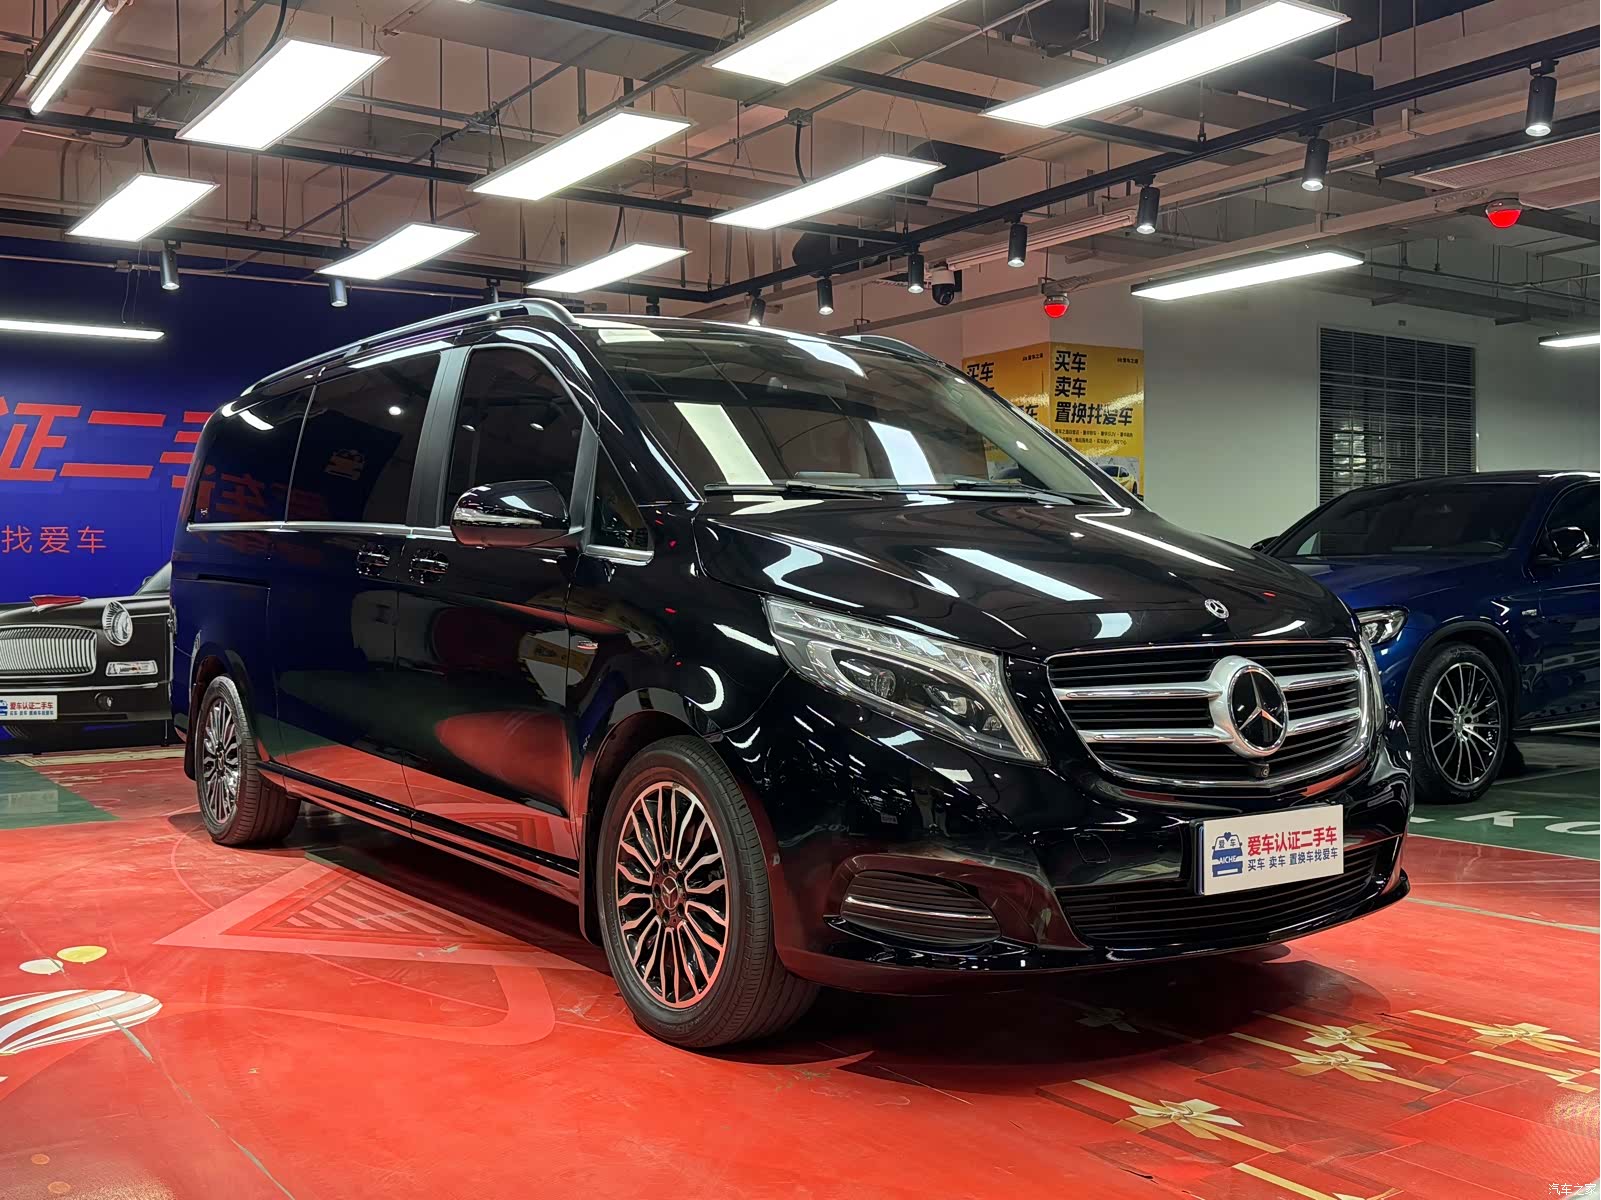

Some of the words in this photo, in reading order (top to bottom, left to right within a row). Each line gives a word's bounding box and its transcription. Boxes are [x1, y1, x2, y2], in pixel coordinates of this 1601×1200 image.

[967, 362, 994, 382] 买车
[1055, 350, 1087, 373] 买车
[1055, 377, 1087, 398] 卖车
[1055, 402, 1133, 426] 置换找爱车
[1, 525, 107, 554] 找爱车
[1248, 826, 1337, 856] 爱车认证二手车
[1248, 858, 1265, 871] 买车
[1269, 855, 1286, 869] 卖车
[1289, 847, 1338, 866] 置换车找爱车
